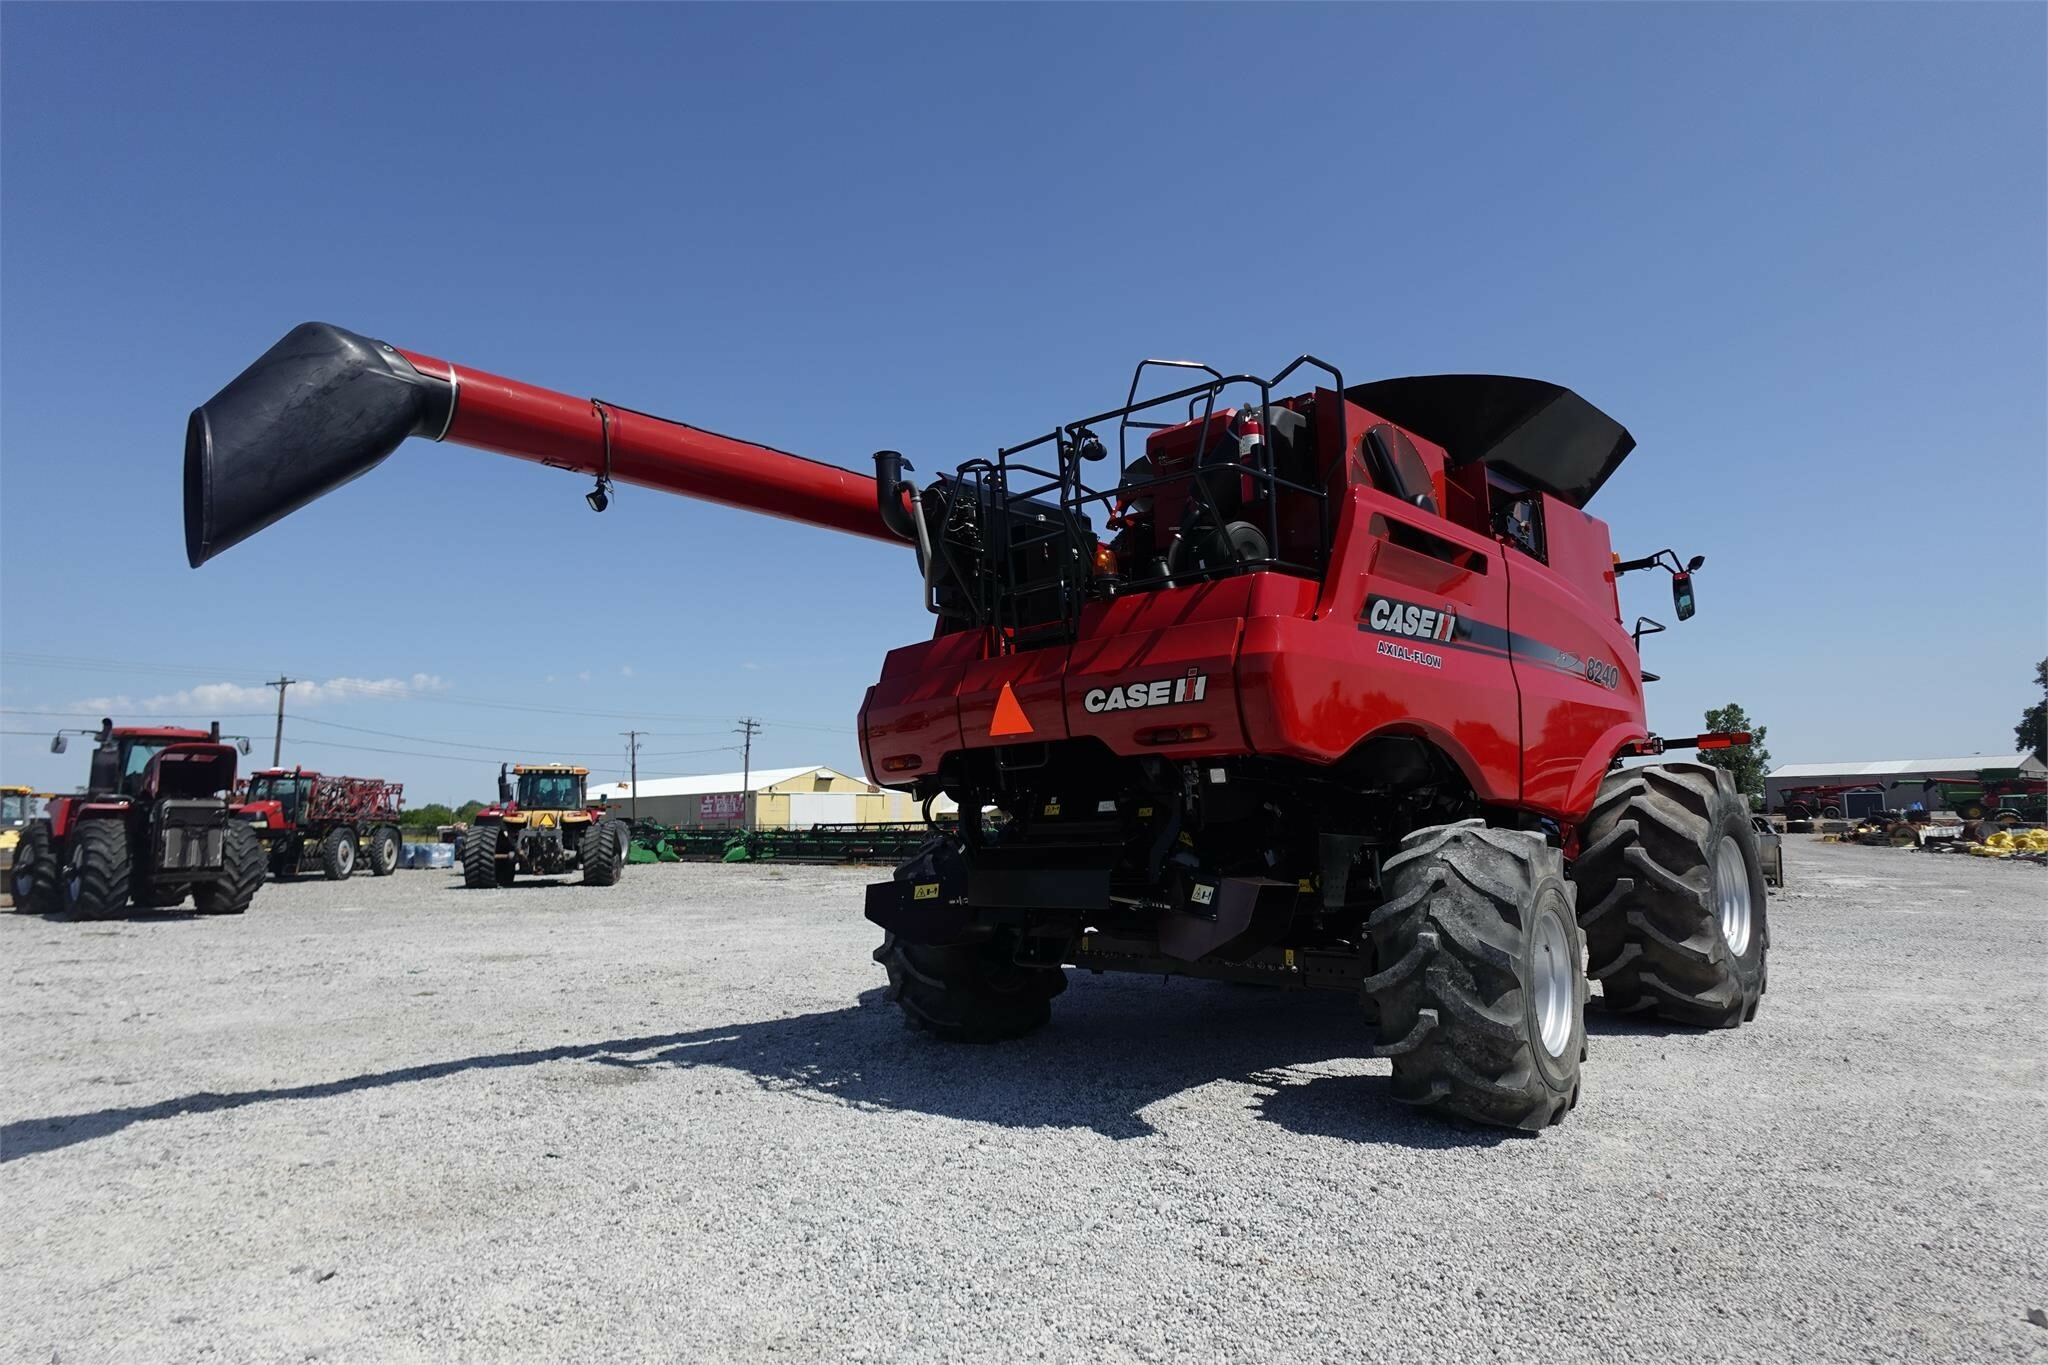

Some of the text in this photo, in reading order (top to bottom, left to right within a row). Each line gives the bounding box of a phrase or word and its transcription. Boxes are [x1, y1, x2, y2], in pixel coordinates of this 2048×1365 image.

[1370, 599, 1436, 638] CASE
[1376, 640, 1442, 669] AXIAL-FLOW
[1586, 656, 1619, 691] 8240
[1084, 680, 1171, 713] CASE
